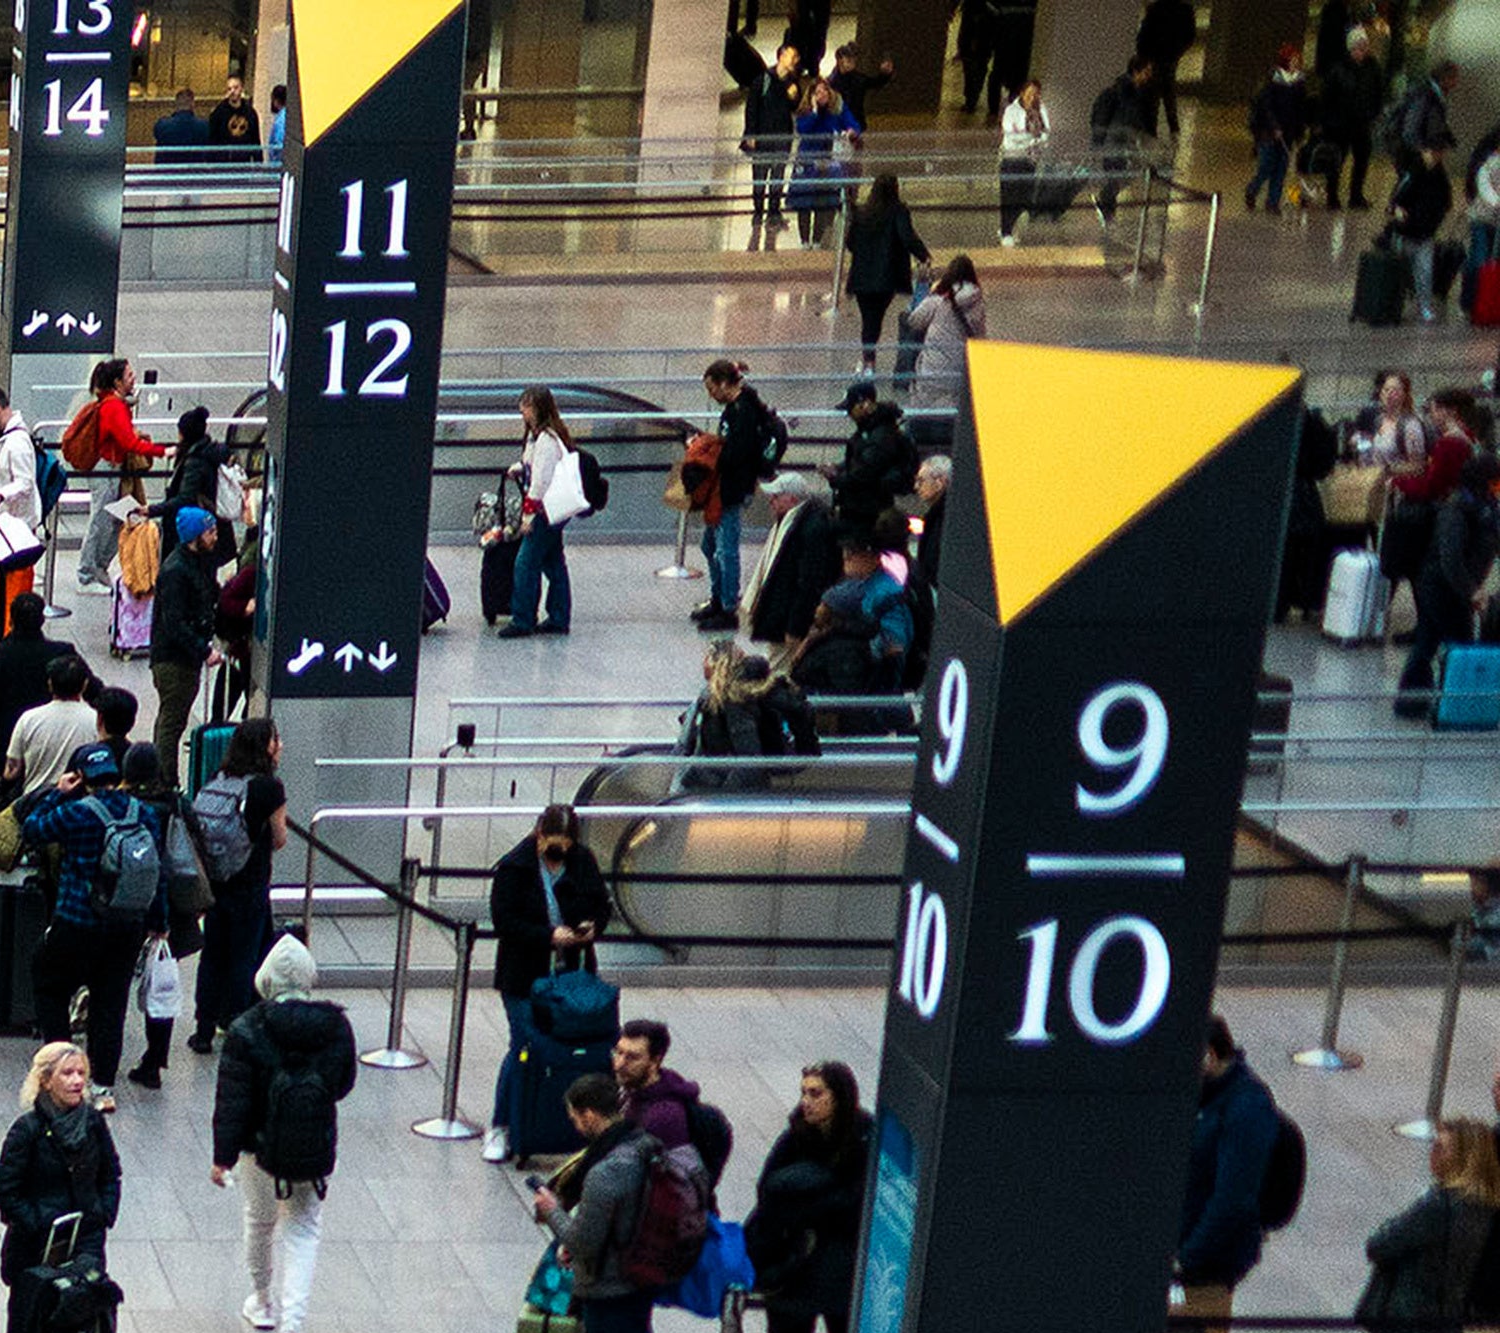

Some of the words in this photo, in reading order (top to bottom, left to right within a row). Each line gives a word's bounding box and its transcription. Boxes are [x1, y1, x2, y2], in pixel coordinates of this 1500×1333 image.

[51, 0, 112, 35] 13
[42, 77, 111, 137] 14
[339, 178, 408, 258] 11
[322, 317, 412, 397] 12
[931, 657, 969, 785] 9
[1076, 684, 1170, 813] 9
[897, 881, 949, 1019] 10
[1010, 914, 1171, 1044] 10
